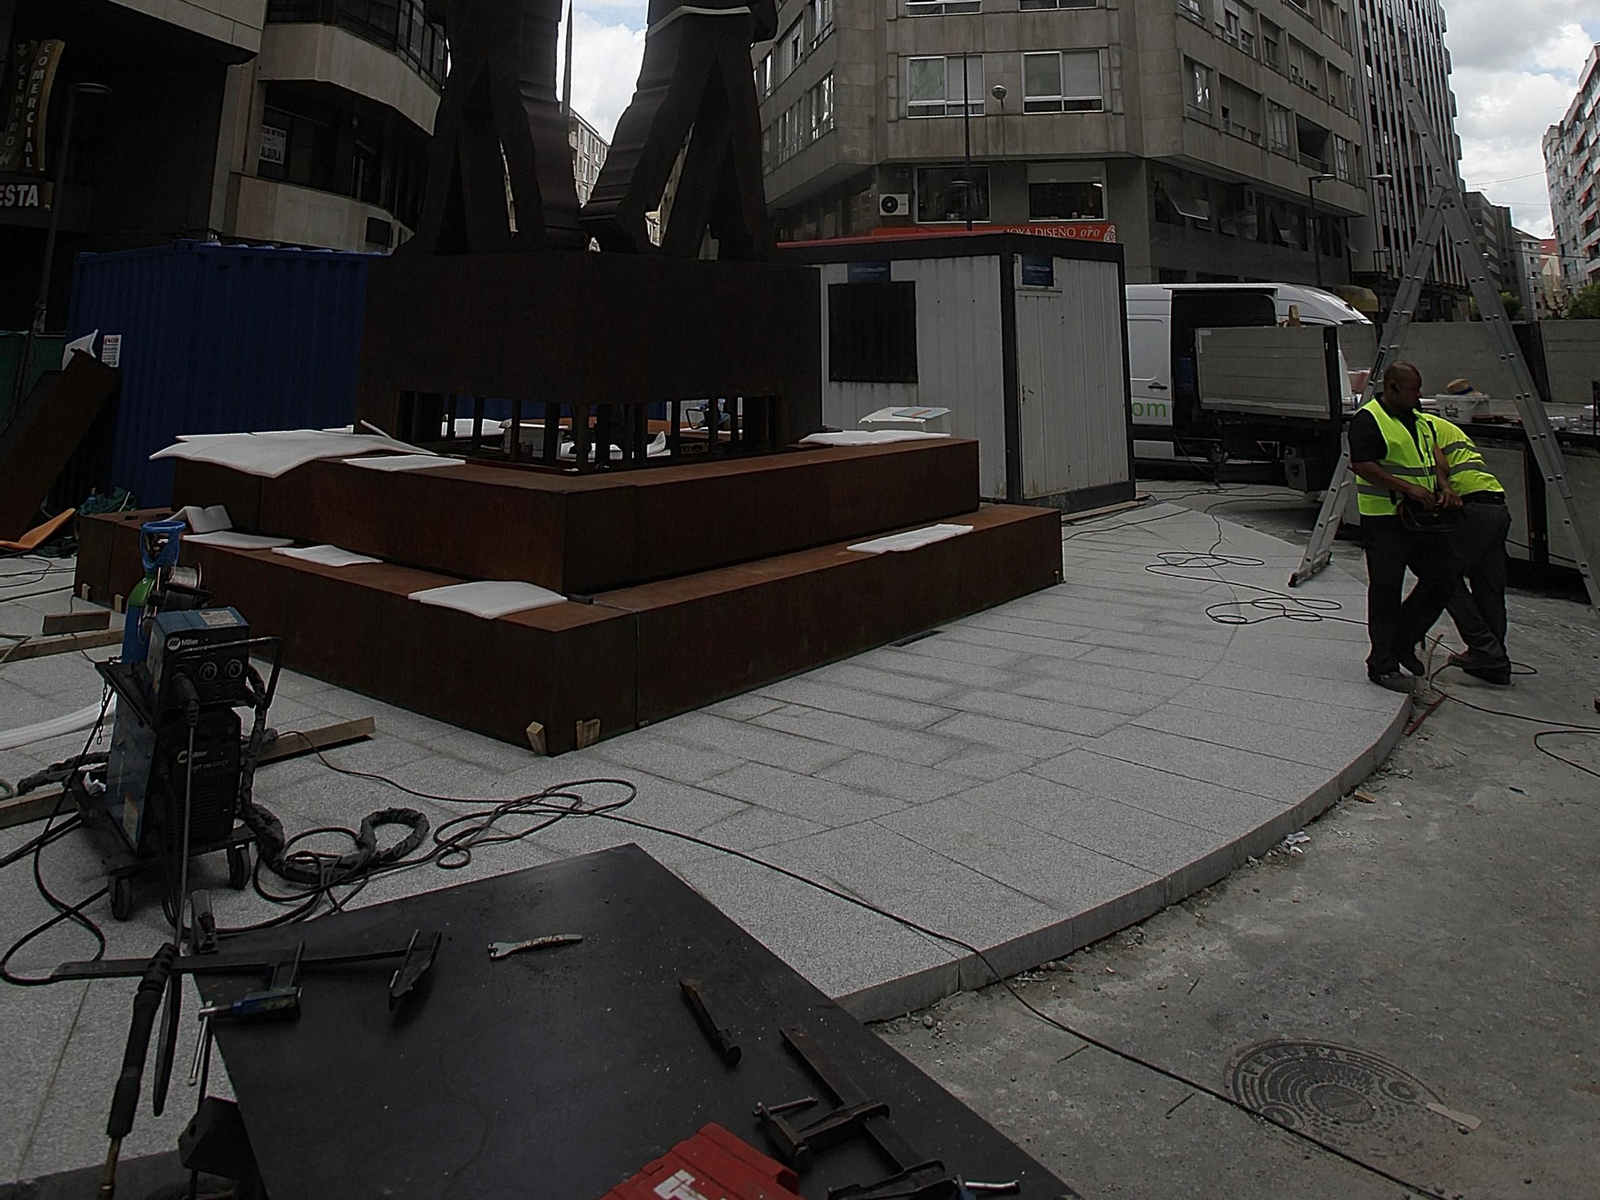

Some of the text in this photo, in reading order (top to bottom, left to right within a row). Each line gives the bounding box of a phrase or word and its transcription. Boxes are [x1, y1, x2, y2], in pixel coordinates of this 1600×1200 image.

[4, 64, 27, 148] CENTRO
[24, 42, 53, 168] COMERCIAL
[1035, 225, 1077, 238] DISEÑO
